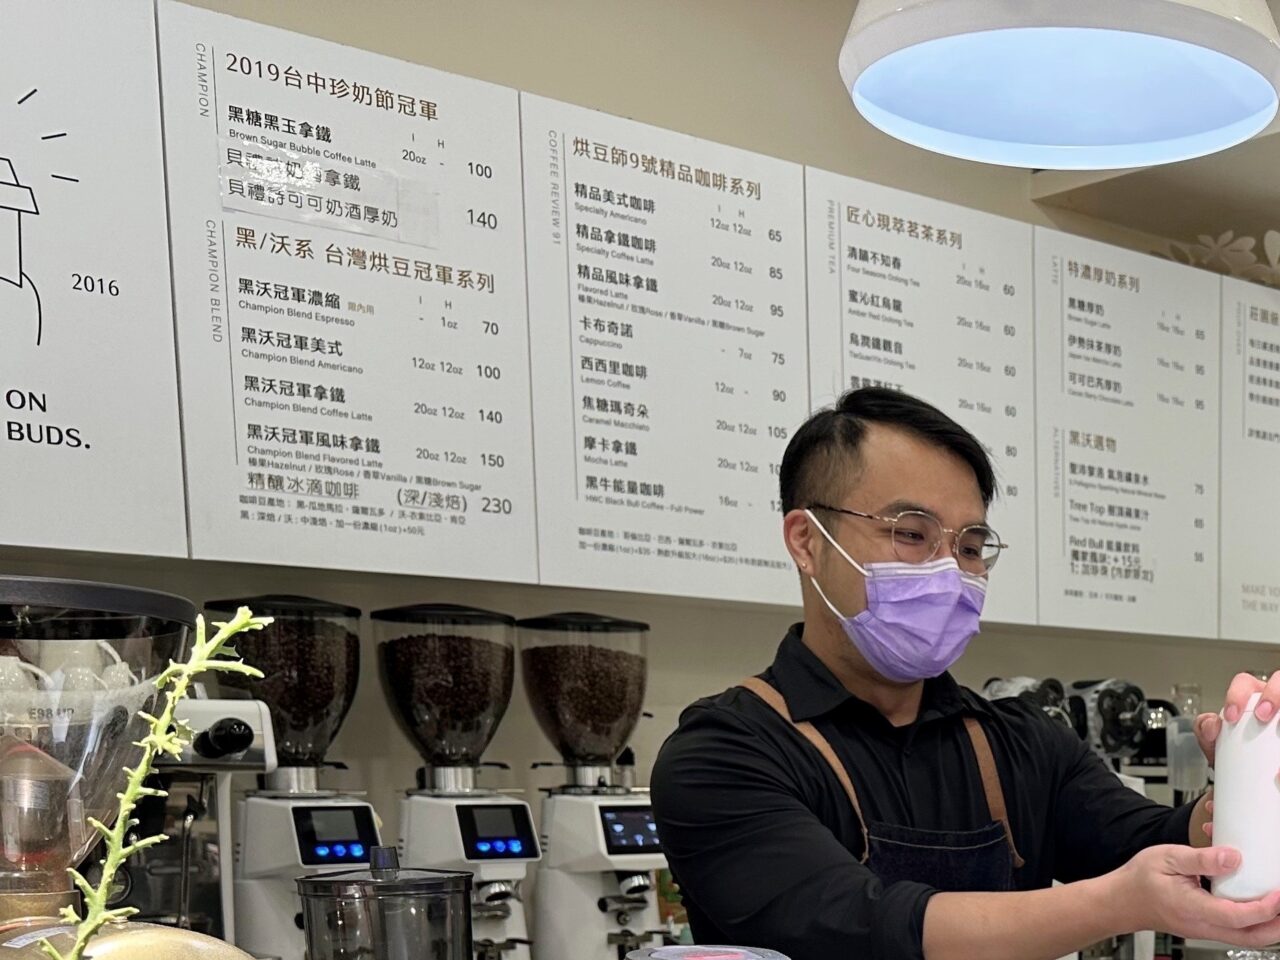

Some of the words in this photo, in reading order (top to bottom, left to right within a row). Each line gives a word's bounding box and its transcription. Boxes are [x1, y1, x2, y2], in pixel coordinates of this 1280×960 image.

[195, 42, 210, 118] CHAMPION
[225, 53, 439, 121] 2019台中珍奶節冠軍
[228, 104, 332, 143] 黑糖黑玉拿鐵
[229, 129, 258, 143] Brown
[260, 135, 287, 149] Sugar
[289, 142, 321, 157] Bubble
[323, 150, 352, 164] Coffee
[354, 157, 377, 169] Latte
[402, 149, 427, 165] 20oz
[467, 162, 493, 179] 100
[548, 129, 559, 178] COFFEE
[572, 135, 761, 201] 烘豆師9號精品咖啡系列
[467, 209, 498, 230] 140
[551, 182, 561, 228] REVIEW
[574, 182, 656, 214] 精品美式咖啡
[768, 229, 782, 242] 65
[574, 202, 608, 218] Specialty
[609, 209, 647, 225] Americano
[205, 219, 219, 292] CHAMPION
[235, 226, 315, 260] 黑/沃系
[325, 243, 495, 294] 台灣烘豆冠軍系列
[576, 223, 657, 254] 精品拿鐵咖啡
[769, 266, 783, 280] 85
[576, 243, 610, 259] Specialty
[611, 249, 634, 263] Coffee
[636, 256, 654, 266] Latte
[71, 273, 120, 297] 2016
[238, 277, 341, 310] 黑沃冠軍濃縮
[577, 263, 658, 293] 精品風味拿鐵
[770, 304, 784, 317] 95
[578, 283, 609, 298] Flavored
[610, 289, 628, 300] Latte
[210, 299, 223, 342] BLEND
[238, 299, 285, 315] Champion
[287, 307, 313, 319] Blend
[315, 311, 355, 327] Espresso
[482, 321, 499, 335] 70
[241, 326, 343, 357] 黑沃冠軍美式
[579, 315, 633, 338] 卡布奇諾
[771, 352, 785, 365] 75
[579, 335, 623, 350] Cappuccino
[241, 348, 287, 365] Champion
[289, 355, 316, 368] Blend
[318, 360, 363, 374] Americano
[412, 356, 435, 371] 12oz
[440, 361, 463, 375] 12oz
[477, 365, 500, 380] 100
[580, 355, 648, 380] 西西里咖啡
[772, 389, 786, 403] 90
[244, 375, 346, 403] 黑沃冠軍拿鐵
[581, 375, 605, 387] Lemon
[607, 379, 631, 390] Coffee
[5, 389, 47, 413] ON
[244, 397, 290, 413] Champion
[292, 403, 318, 416] Blend
[320, 406, 349, 419] Coffee
[351, 411, 373, 422] Latte
[414, 402, 437, 417] 20oz
[442, 406, 465, 420] 12oz
[479, 409, 502, 424] 140
[582, 395, 649, 419] 焦糖瑪奇朵
[768, 426, 787, 439] 105
[582, 415, 612, 427] Caramel
[614, 419, 650, 432] Macchiato
[7, 421, 91, 449] BUDS.
[247, 424, 381, 454] 黑沃冠軍風味拿鐵
[584, 435, 638, 456] 摩卡拿鐵
[247, 445, 293, 460] Champion
[295, 450, 321, 463] Blend
[322, 453, 360, 467] Flavored
[361, 459, 383, 469] Latte
[416, 448, 439, 461] 20oz
[444, 451, 467, 465] 12oz
[480, 454, 504, 468] 150
[584, 454, 608, 466] Mocha
[585, 475, 665, 498] 黑牛能量咖啡
[481, 497, 512, 515] 230
